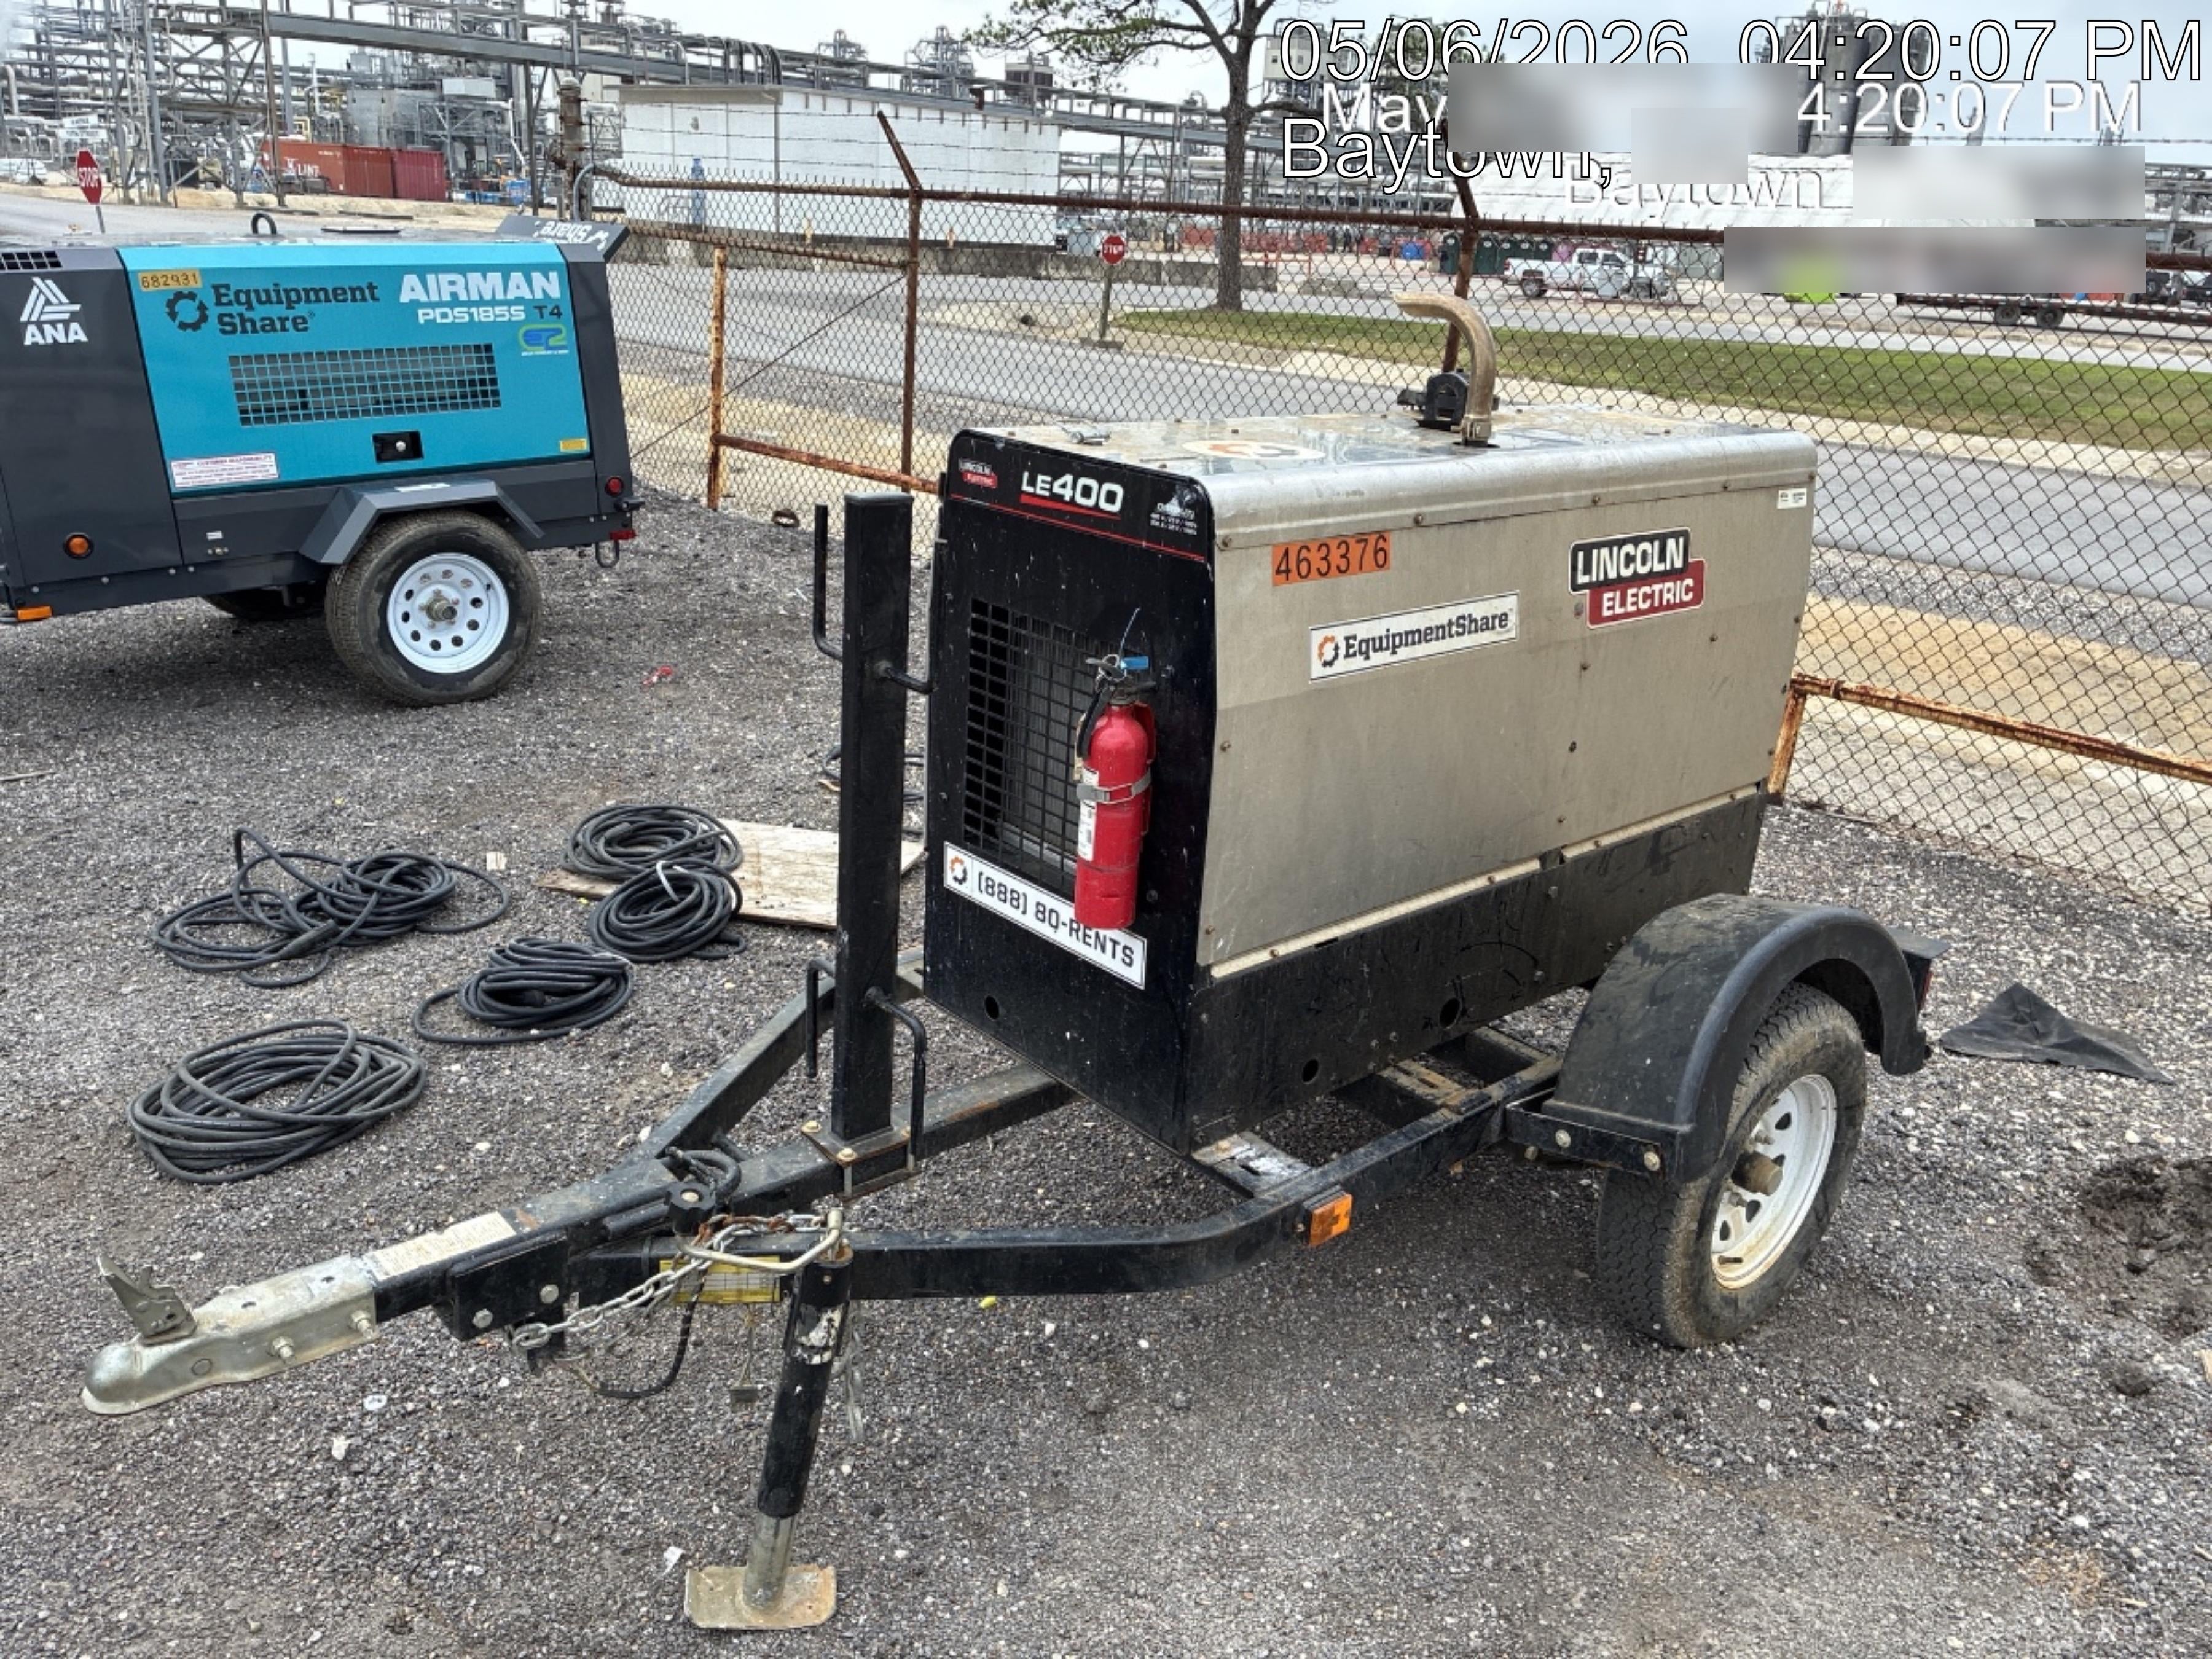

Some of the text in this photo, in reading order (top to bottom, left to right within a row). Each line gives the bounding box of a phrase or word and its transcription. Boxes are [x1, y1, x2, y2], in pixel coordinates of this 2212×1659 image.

[78, 167, 99, 189] STOP
[141, 274, 198, 288] 682931
[211, 281, 380, 310] Equipment
[399, 271, 561, 303] AIRMAN
[418, 305, 525, 324] PDS185S
[23, 322, 89, 346] ANA
[1021, 471, 1124, 514] LE400
[1274, 534, 1388, 582] 463376
[1577, 536, 1684, 585] LINCOLN
[1602, 577, 1694, 617] ELECTRIC
[1343, 610, 1510, 661] EquipmentShare
[978, 871, 1027, 916] (888)
